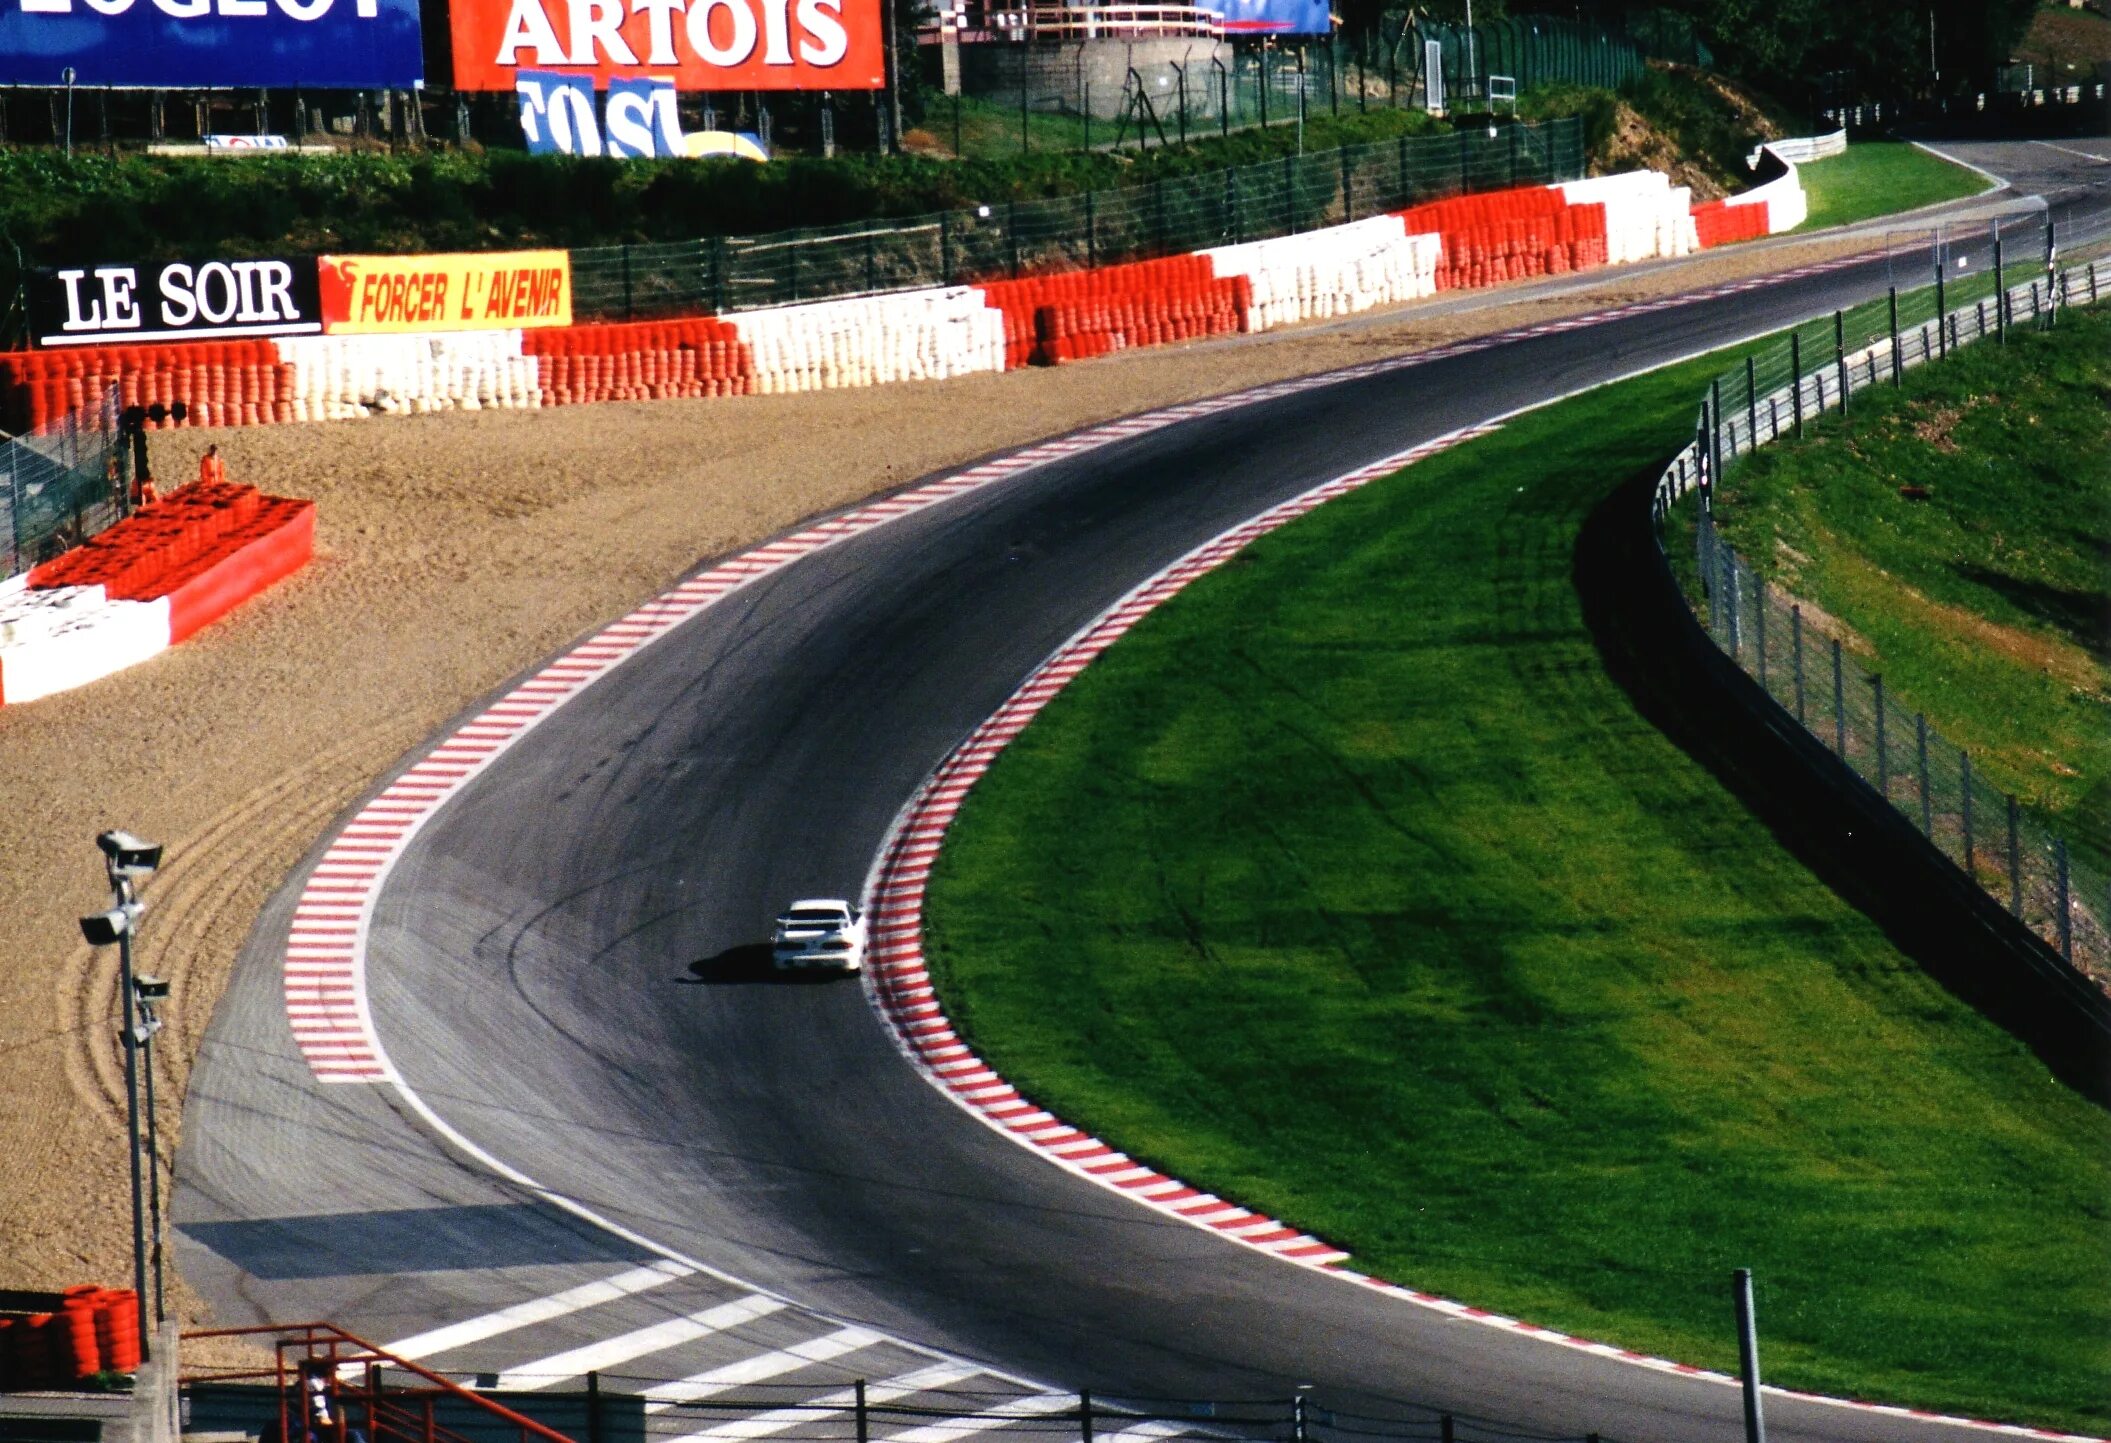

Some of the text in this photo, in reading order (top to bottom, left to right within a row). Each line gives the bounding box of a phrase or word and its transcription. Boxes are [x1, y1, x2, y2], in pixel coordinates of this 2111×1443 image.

[496, 0, 848, 67] ARTOIS
[58, 260, 300, 331] LE SOIR
[360, 272, 449, 323] FORCER
